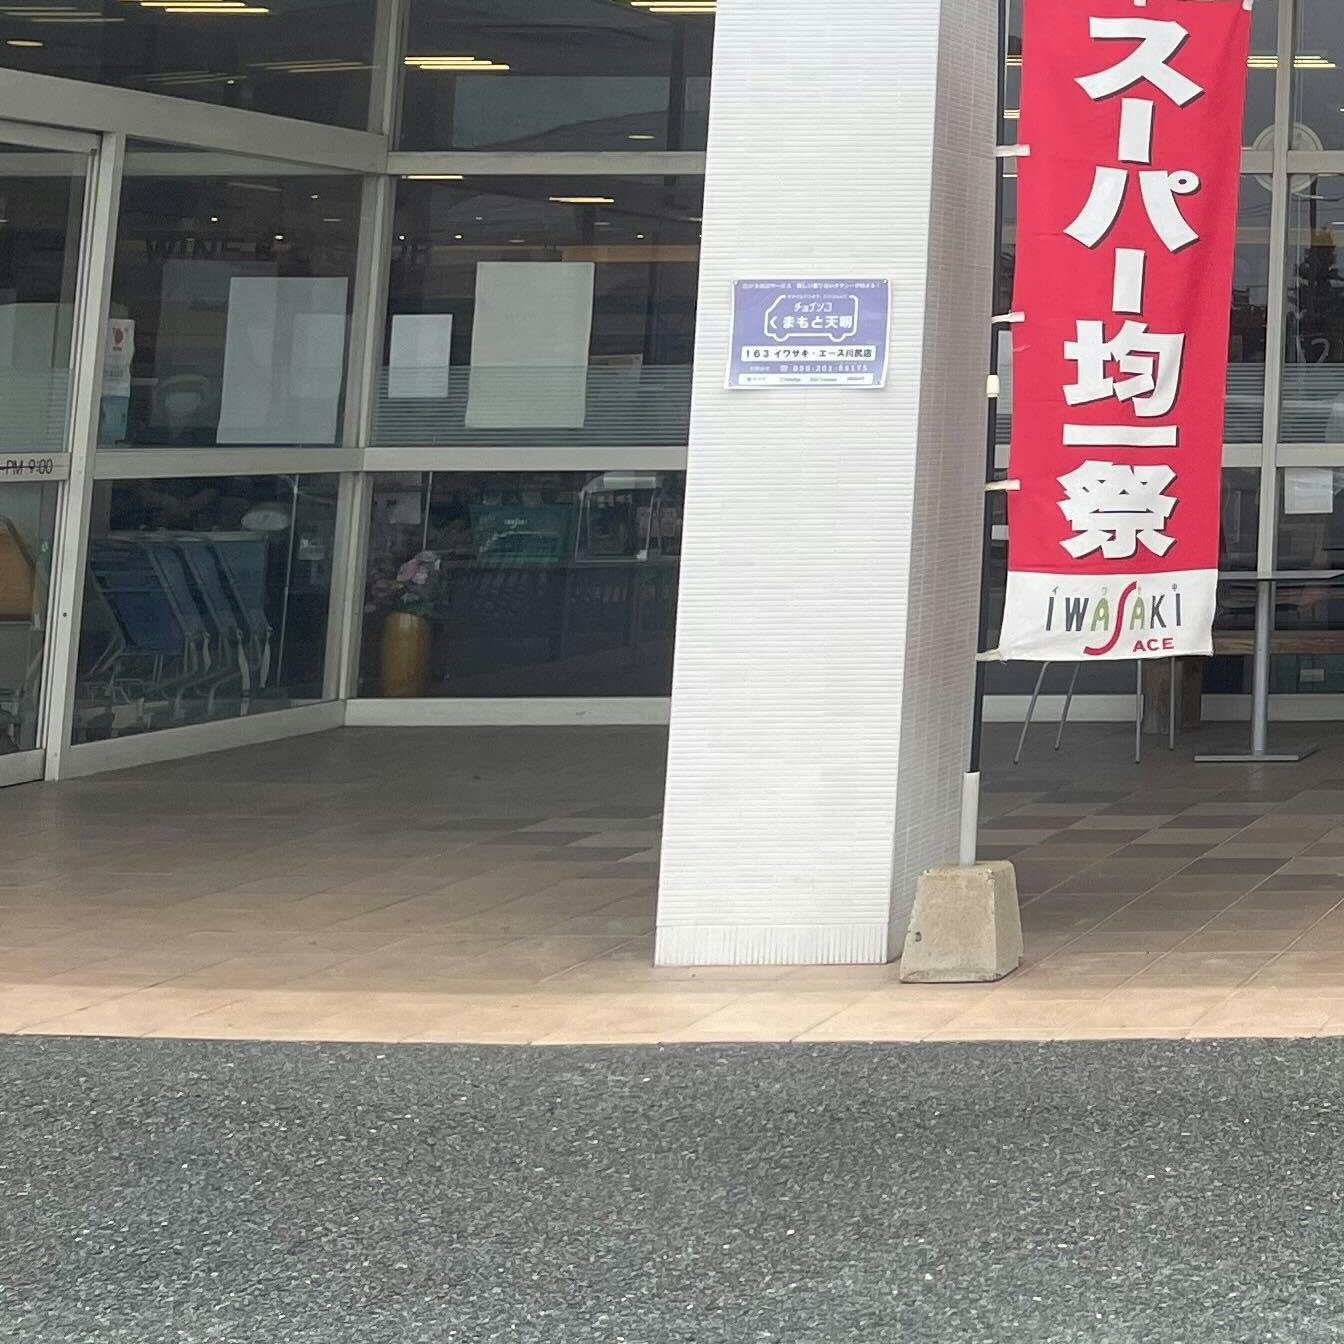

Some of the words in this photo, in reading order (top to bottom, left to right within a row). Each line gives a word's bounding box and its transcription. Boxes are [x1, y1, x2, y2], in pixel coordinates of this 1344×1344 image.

[1056, 16, 1205, 560] スーパー均一祭
[769, 315, 853, 329] くまもと天明
[1045, 580, 1182, 656] IWASAKI
[1132, 637, 1176, 653] ACE
